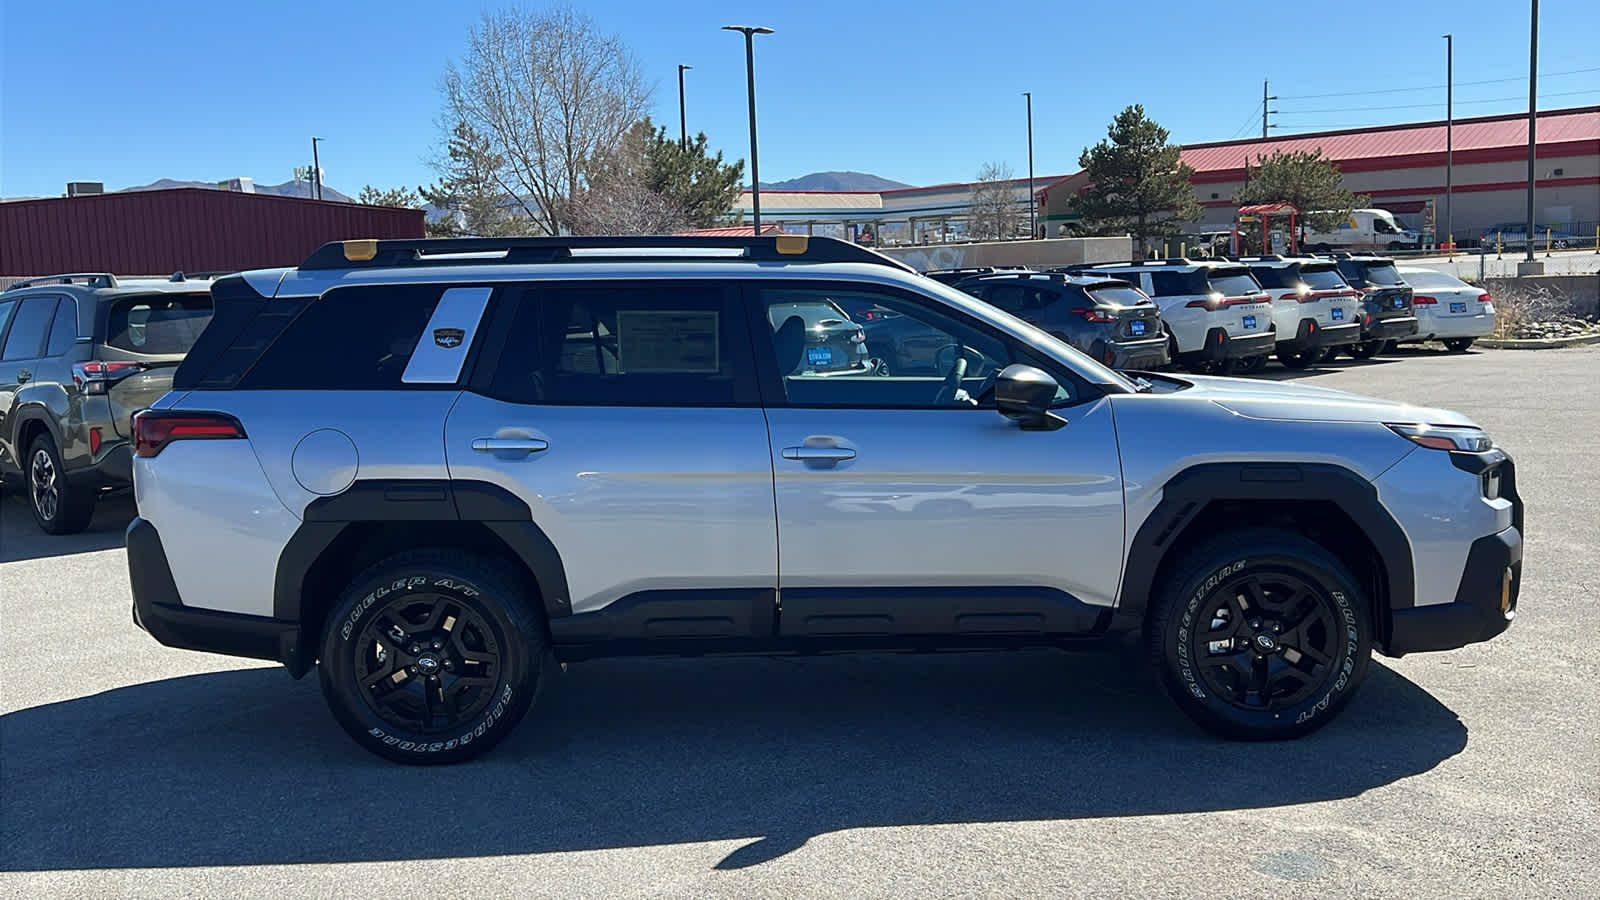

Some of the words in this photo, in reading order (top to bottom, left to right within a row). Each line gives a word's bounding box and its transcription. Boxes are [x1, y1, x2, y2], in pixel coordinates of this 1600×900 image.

[341, 575, 427, 641] DUELER
[434, 578, 480, 597] A/T
[1177, 560, 1247, 699] BRIDGESTONE
[1332, 591, 1359, 692] DUELER
[368, 683, 513, 752] BRIDGESTONE
[1295, 692, 1332, 725] A/T
